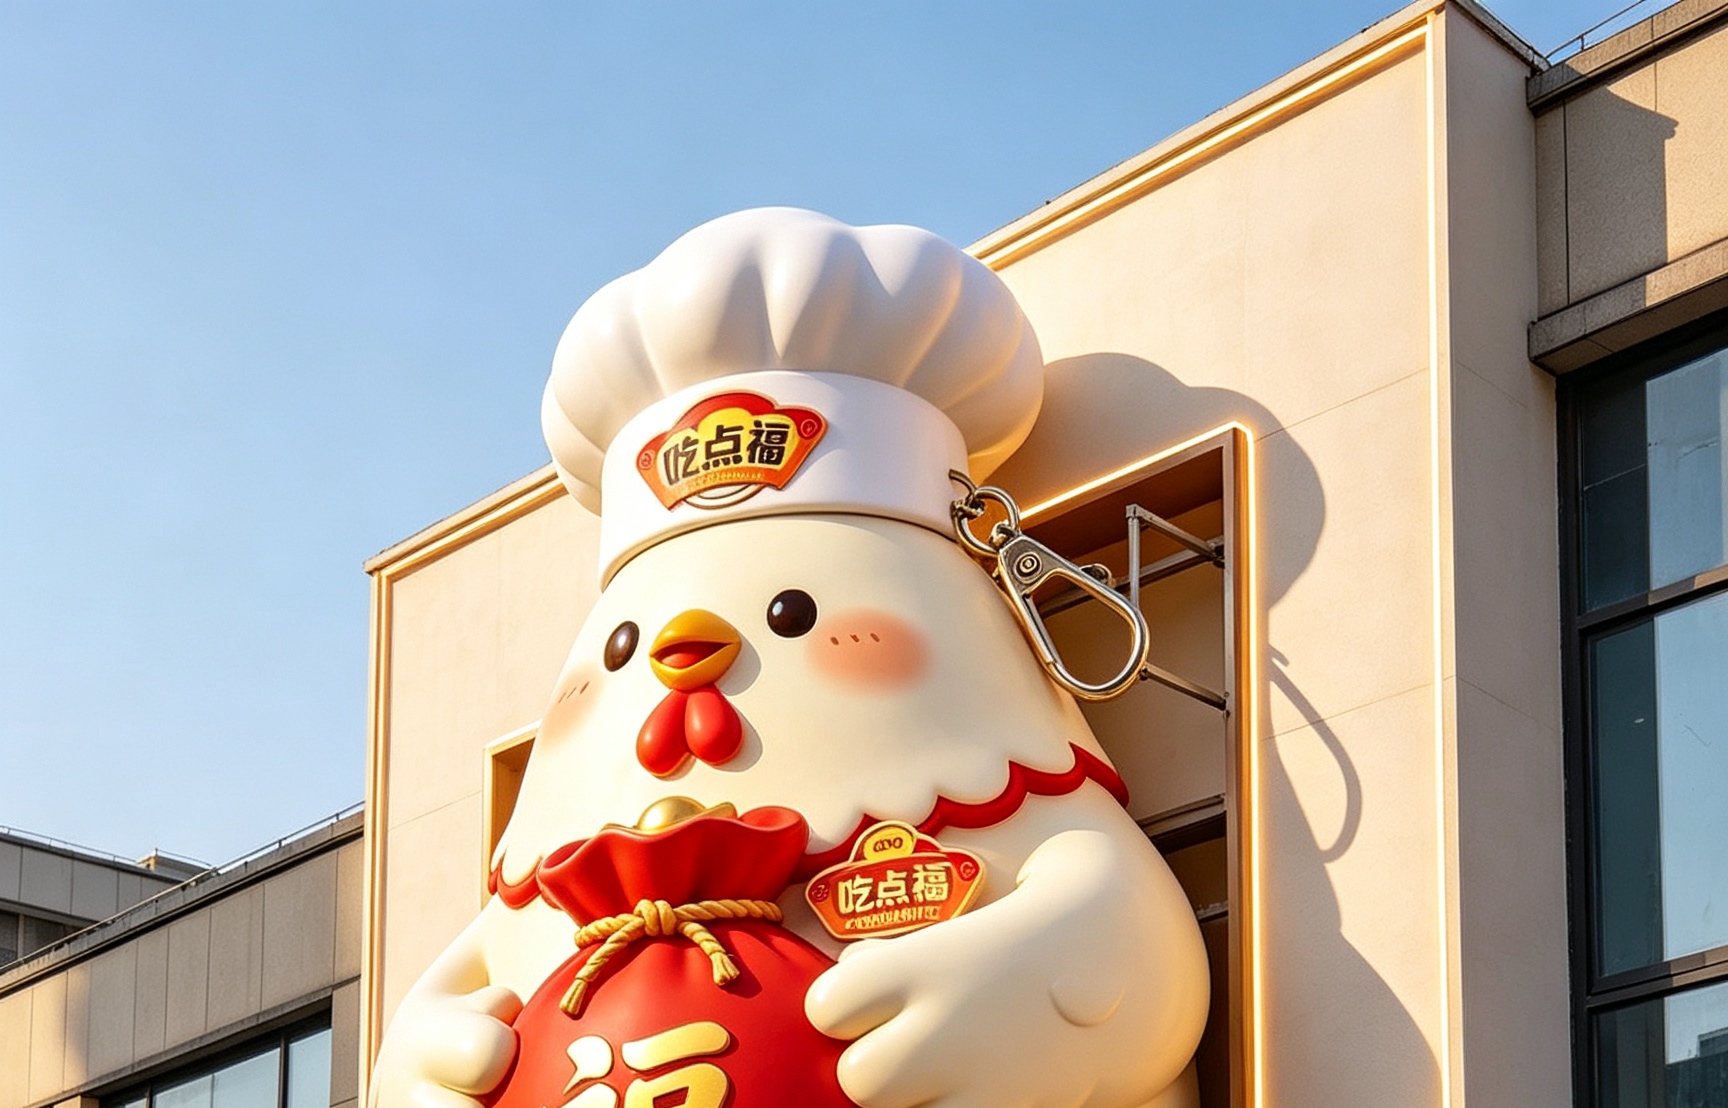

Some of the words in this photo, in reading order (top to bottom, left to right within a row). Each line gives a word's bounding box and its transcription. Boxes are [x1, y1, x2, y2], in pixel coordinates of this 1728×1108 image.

[663, 420, 790, 486] 吃点福
[838, 862, 951, 915] 吃点福
